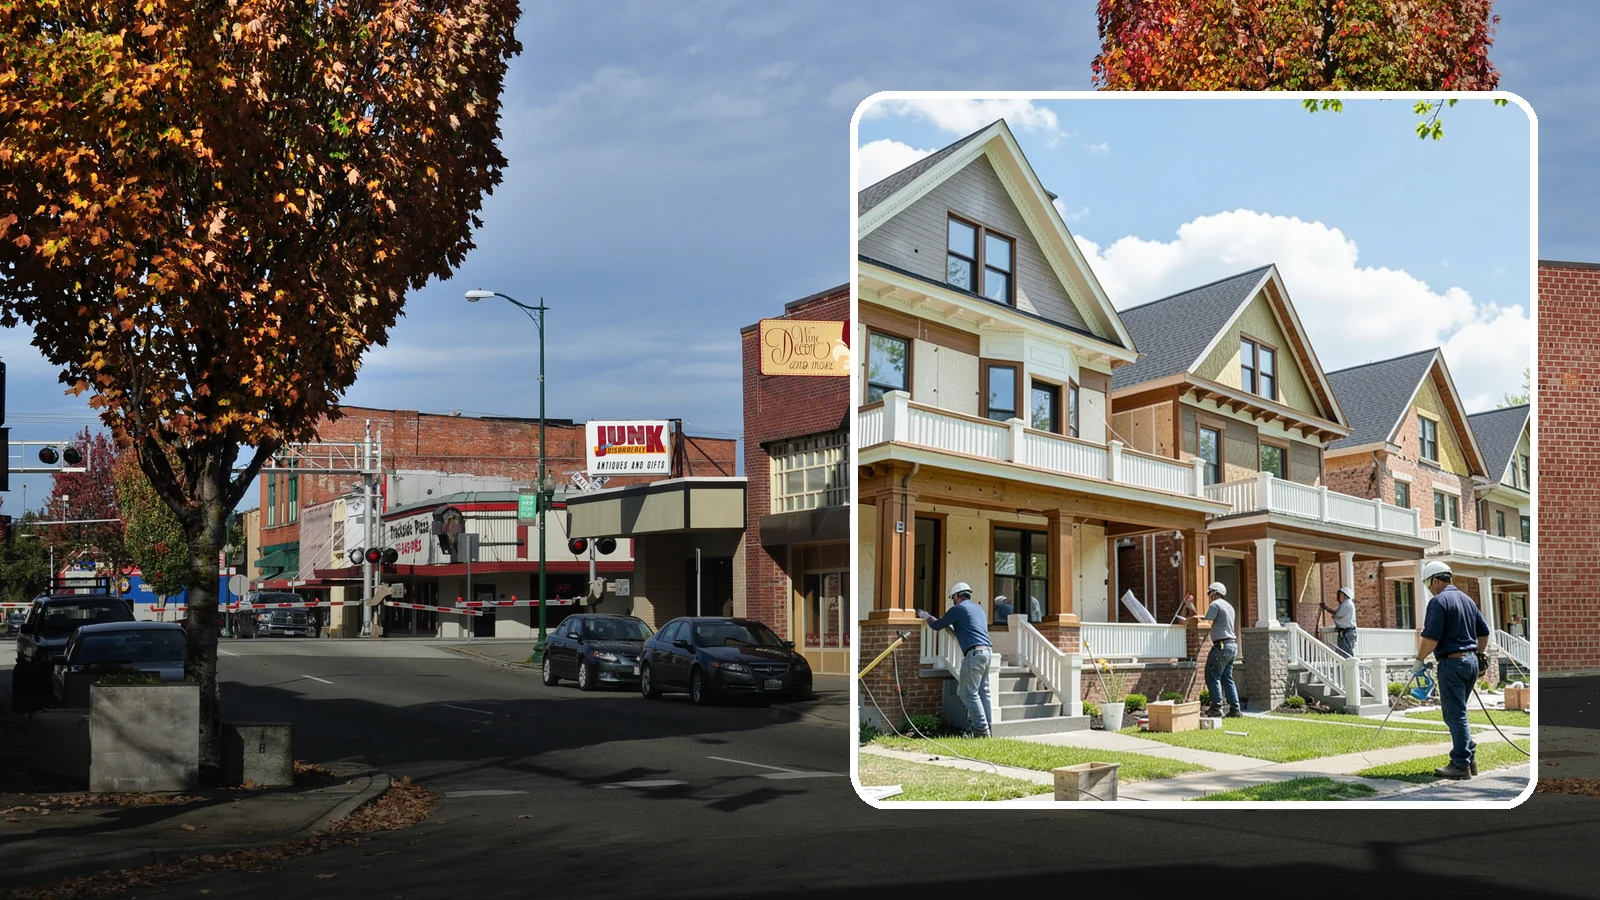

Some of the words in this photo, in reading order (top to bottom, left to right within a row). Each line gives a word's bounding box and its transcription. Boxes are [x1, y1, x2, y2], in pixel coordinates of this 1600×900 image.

[595, 425, 665, 457] JUNK
[607, 446, 647, 454] DISORDERLY
[596, 461, 628, 470] ANTIQUES
[631, 460, 644, 470] AND
[647, 460, 665, 469] GIFTS
[573, 473, 587, 491] RAIL
[587, 476, 609, 492] SING
[390, 521, 413, 540] Trackside
[414, 519, 429, 535] Pizza
